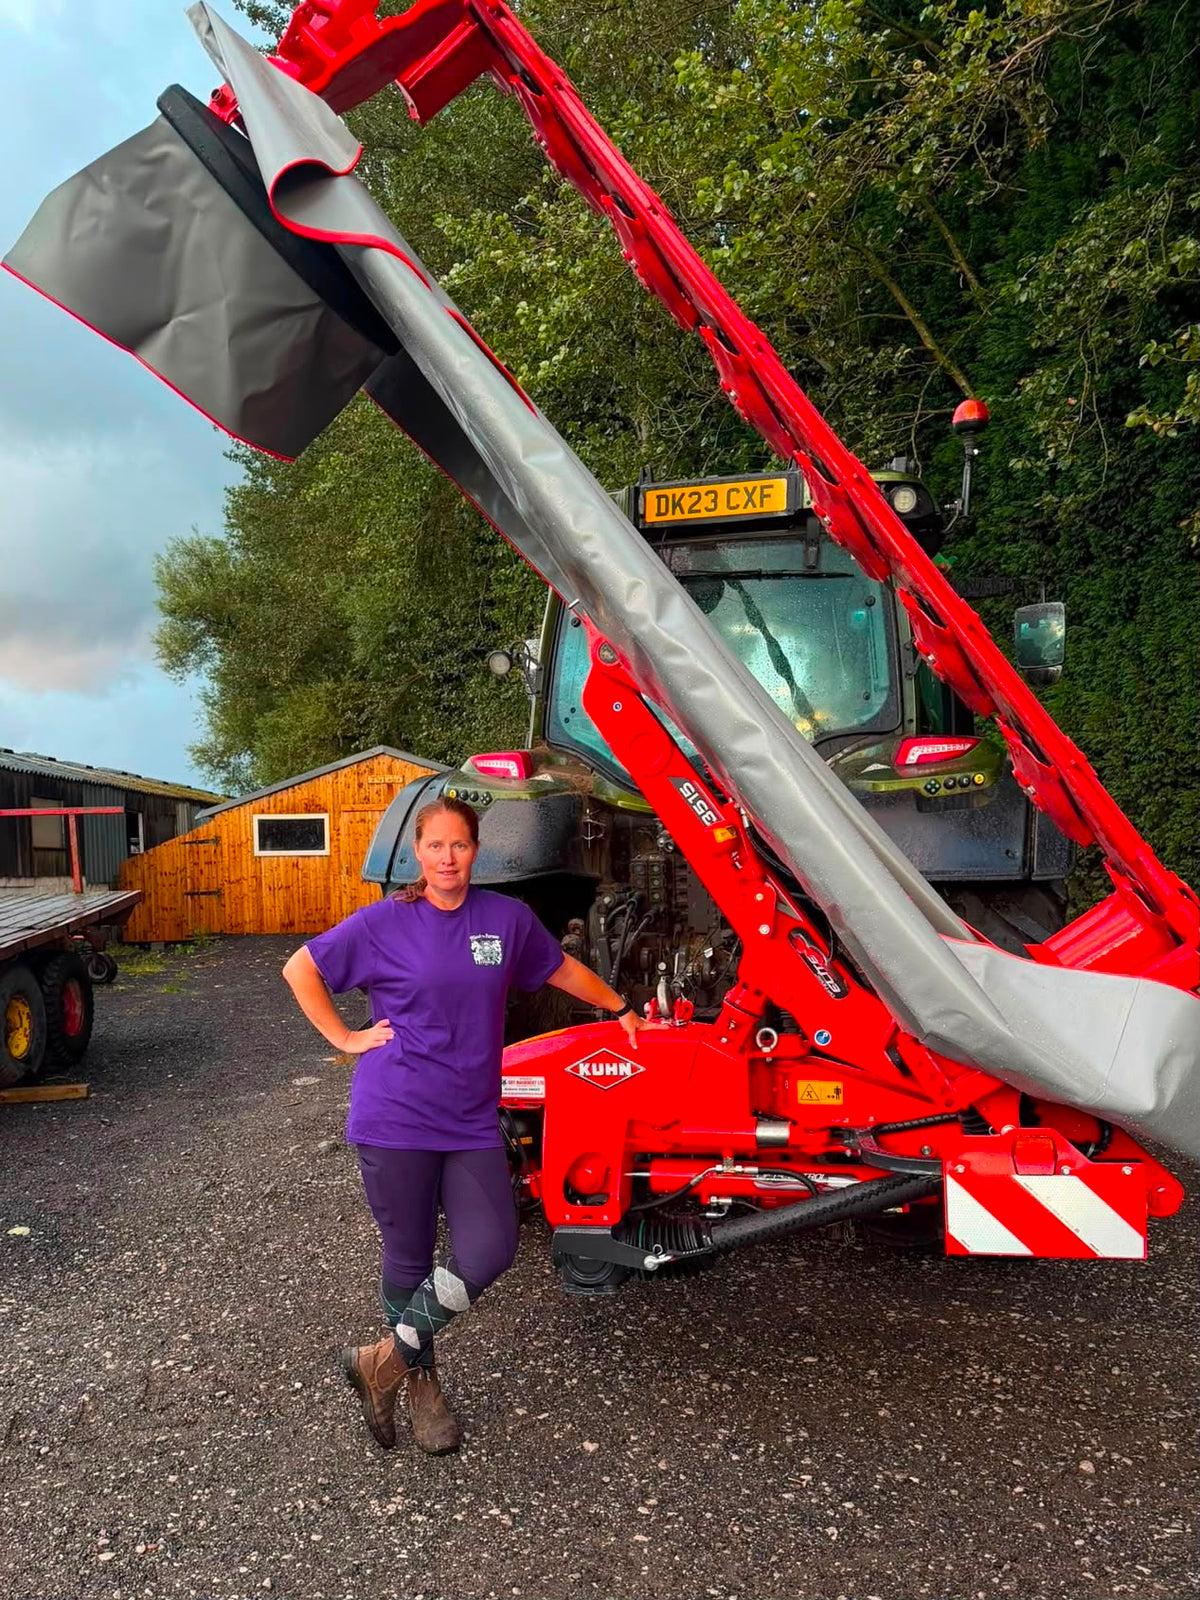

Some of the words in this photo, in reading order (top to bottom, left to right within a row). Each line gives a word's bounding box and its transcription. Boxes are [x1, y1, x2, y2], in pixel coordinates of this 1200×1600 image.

[655, 489, 719, 517] DK23
[726, 484, 774, 511] CXF
[679, 782, 717, 826] 3515
[807, 954, 841, 993] ELITE
[579, 1062, 632, 1076] KUHN
